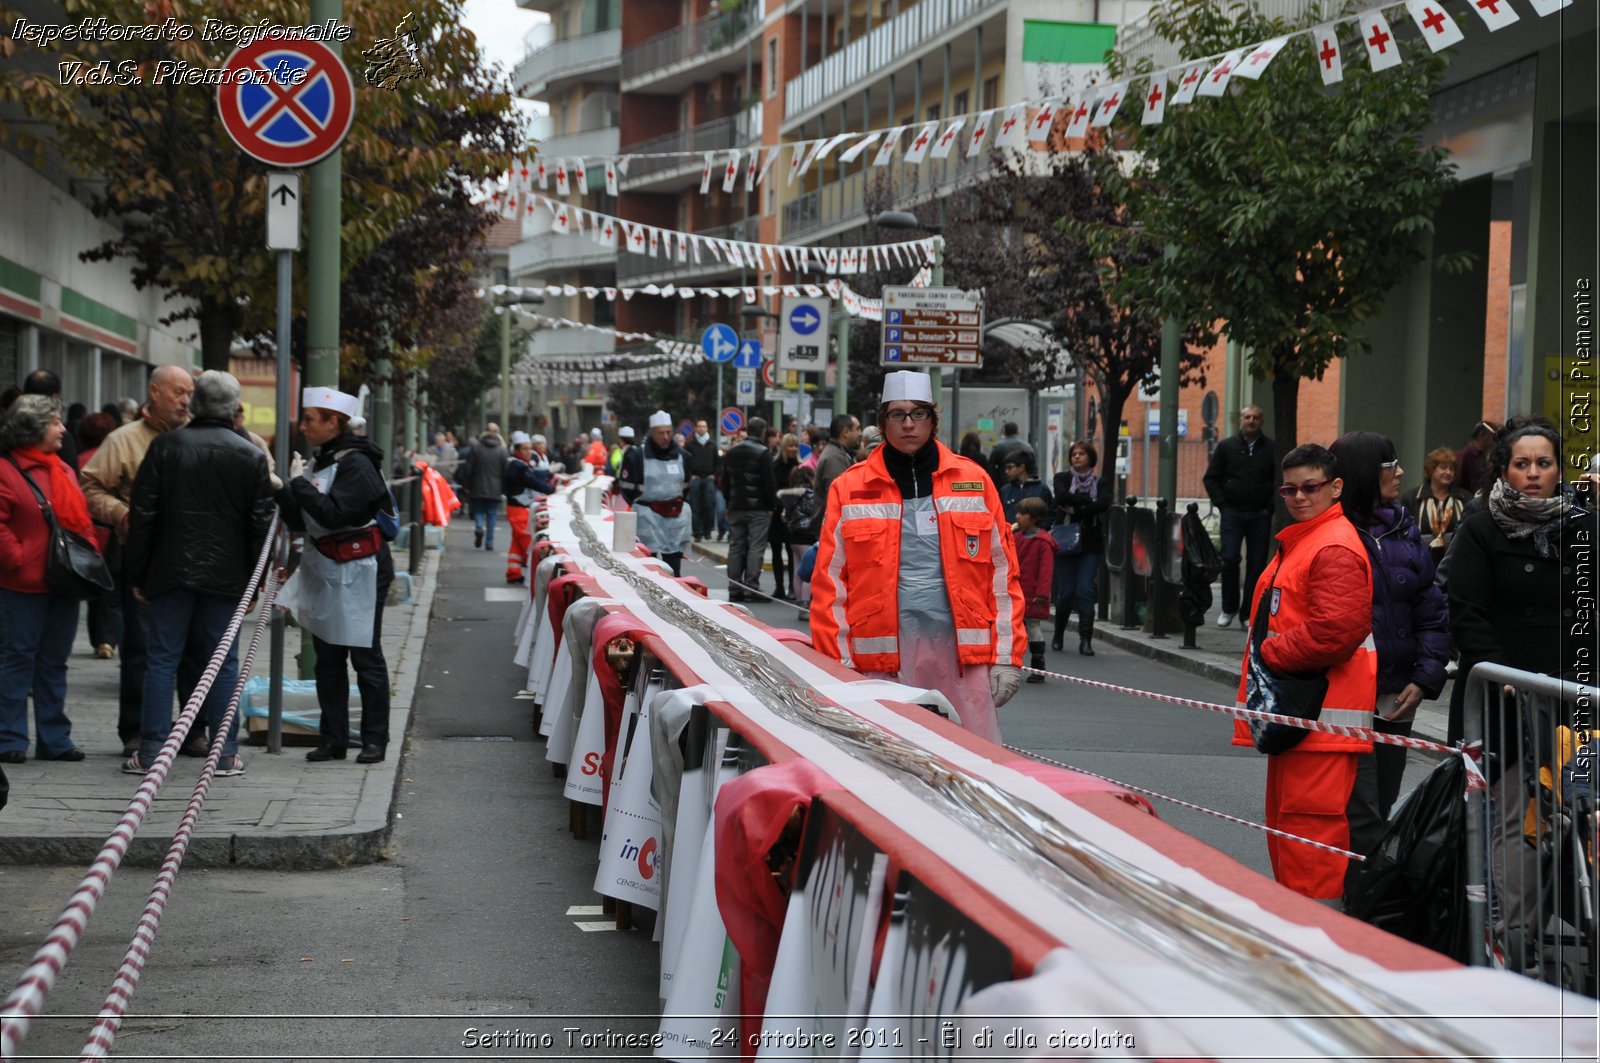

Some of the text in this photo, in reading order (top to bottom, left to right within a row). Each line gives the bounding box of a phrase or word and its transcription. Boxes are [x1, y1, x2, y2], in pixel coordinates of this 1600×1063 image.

[890, 311, 899, 323] P
[890, 329, 899, 341] P
[888, 348, 898, 360] P
